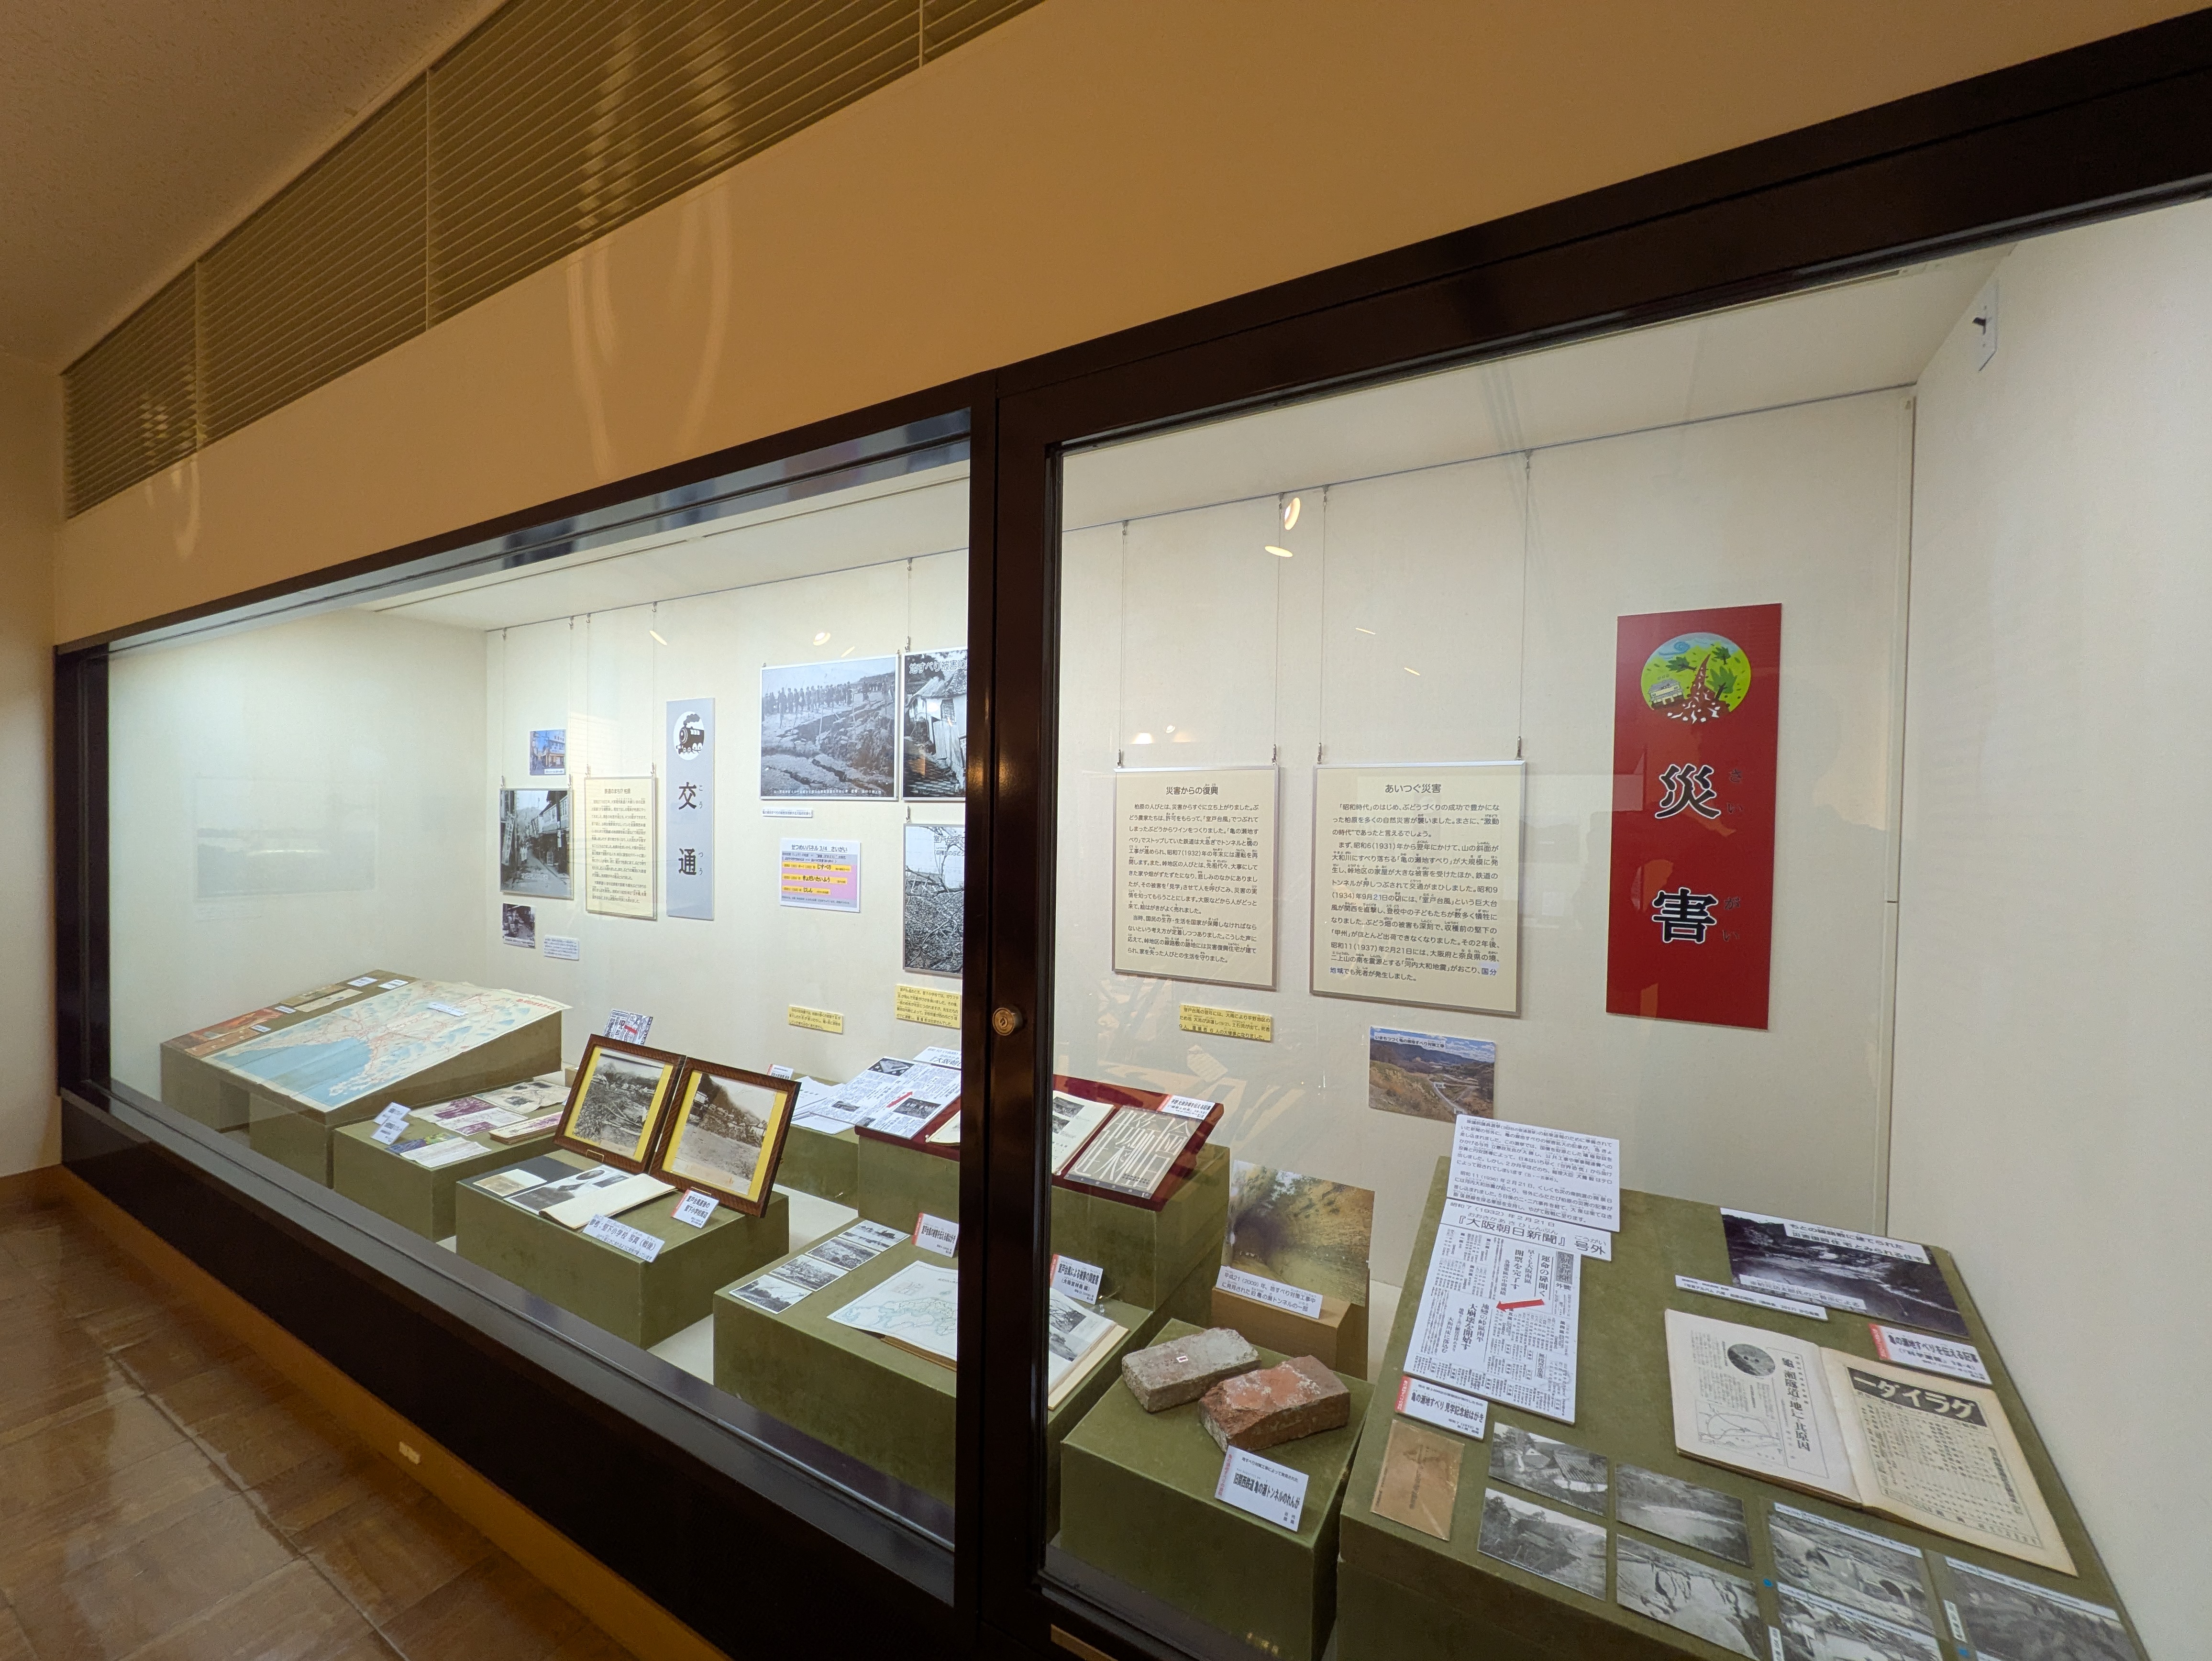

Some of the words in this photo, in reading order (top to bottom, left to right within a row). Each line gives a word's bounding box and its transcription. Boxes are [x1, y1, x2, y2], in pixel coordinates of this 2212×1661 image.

[1166, 786, 1218, 795] 災害からの復興
[1385, 784, 1441, 793] あいつぐ災害
[678, 782, 697, 875] 交通
[1129, 826, 1259, 834] しまったぶどうからワインをつくりました。「亀の瀬地す
[1128, 837, 1258, 847] べり」でストップしていた鉄道は大急ぎでトンネルと橋の
[1332, 855, 1498, 865] 大和川にすべり落ちる「亀の瀬地すべり」が大規模に発
[1652, 763, 1722, 945] 災害
[1128, 859, 1258, 870] 開します。また、峠地区の人びとは、先祖代々、大事にして
[1128, 870, 1258, 882] きた家や畑がずたずたになり、悲しみのなかにありまし
[1332, 867, 1498, 879] 生し、峠地区の家屋が大きな被害を受けたほか、鉄道の
[1128, 881, 1257, 895] たが、その被害を「見学」させて人を呼びこみ、災害の実
[1332, 879, 1498, 893] トンネルが押しつぶされて交通がまひしました。昭和9
[1128, 893, 1257, 906] 情を知ってもらうことにします。大阪などから人がどっと
[1128, 903, 1201, 914] 来て、絵はがきがよく売れました。
[1331, 904, 1497, 920] 風が関西を直撃し、登校中の子どもたちが数多く犠牲に
[1133, 915, 1257, 930] 当時、国民の生存・生活を国家が保障しなければなら
[1331, 917, 1497, 934] なりました。ぶどう畑の被害も深刻で、収穫前の堅下の
[1128, 925, 1257, 942] ないという考え方が定着しつつありました。こうした声に
[1331, 929, 1500, 948] 「甲州」がほとんど出荷できなくなりました。その2年後、
[1128, 936, 1256, 953] 応えて、峠地区の線路敷の跡地には災害復興住宅が建て
[1127, 948, 1228, 963] られ、家を失った人びとの生活を守りました。
[1331, 954, 1497, 975] 二上山の南を震源とする「河内大和地震」がおこり、国分
[1330, 967, 1416, 981] 地域でも死者が発生しました。
[1375, 1035, 1445, 1048] いまもつづく亀の瀬地すべり対策工事
[1459, 1215, 1565, 1246] 『大阪朝日新聞』
[1574, 1241, 1606, 1255] 号外
[1411, 1392, 1445, 1410] 亀の瀬地すべり
[1444, 1402, 1484, 1423] 見学記念絵はがき
[1254, 1479, 1300, 1509] 亀の瀬トンネルのれんが
